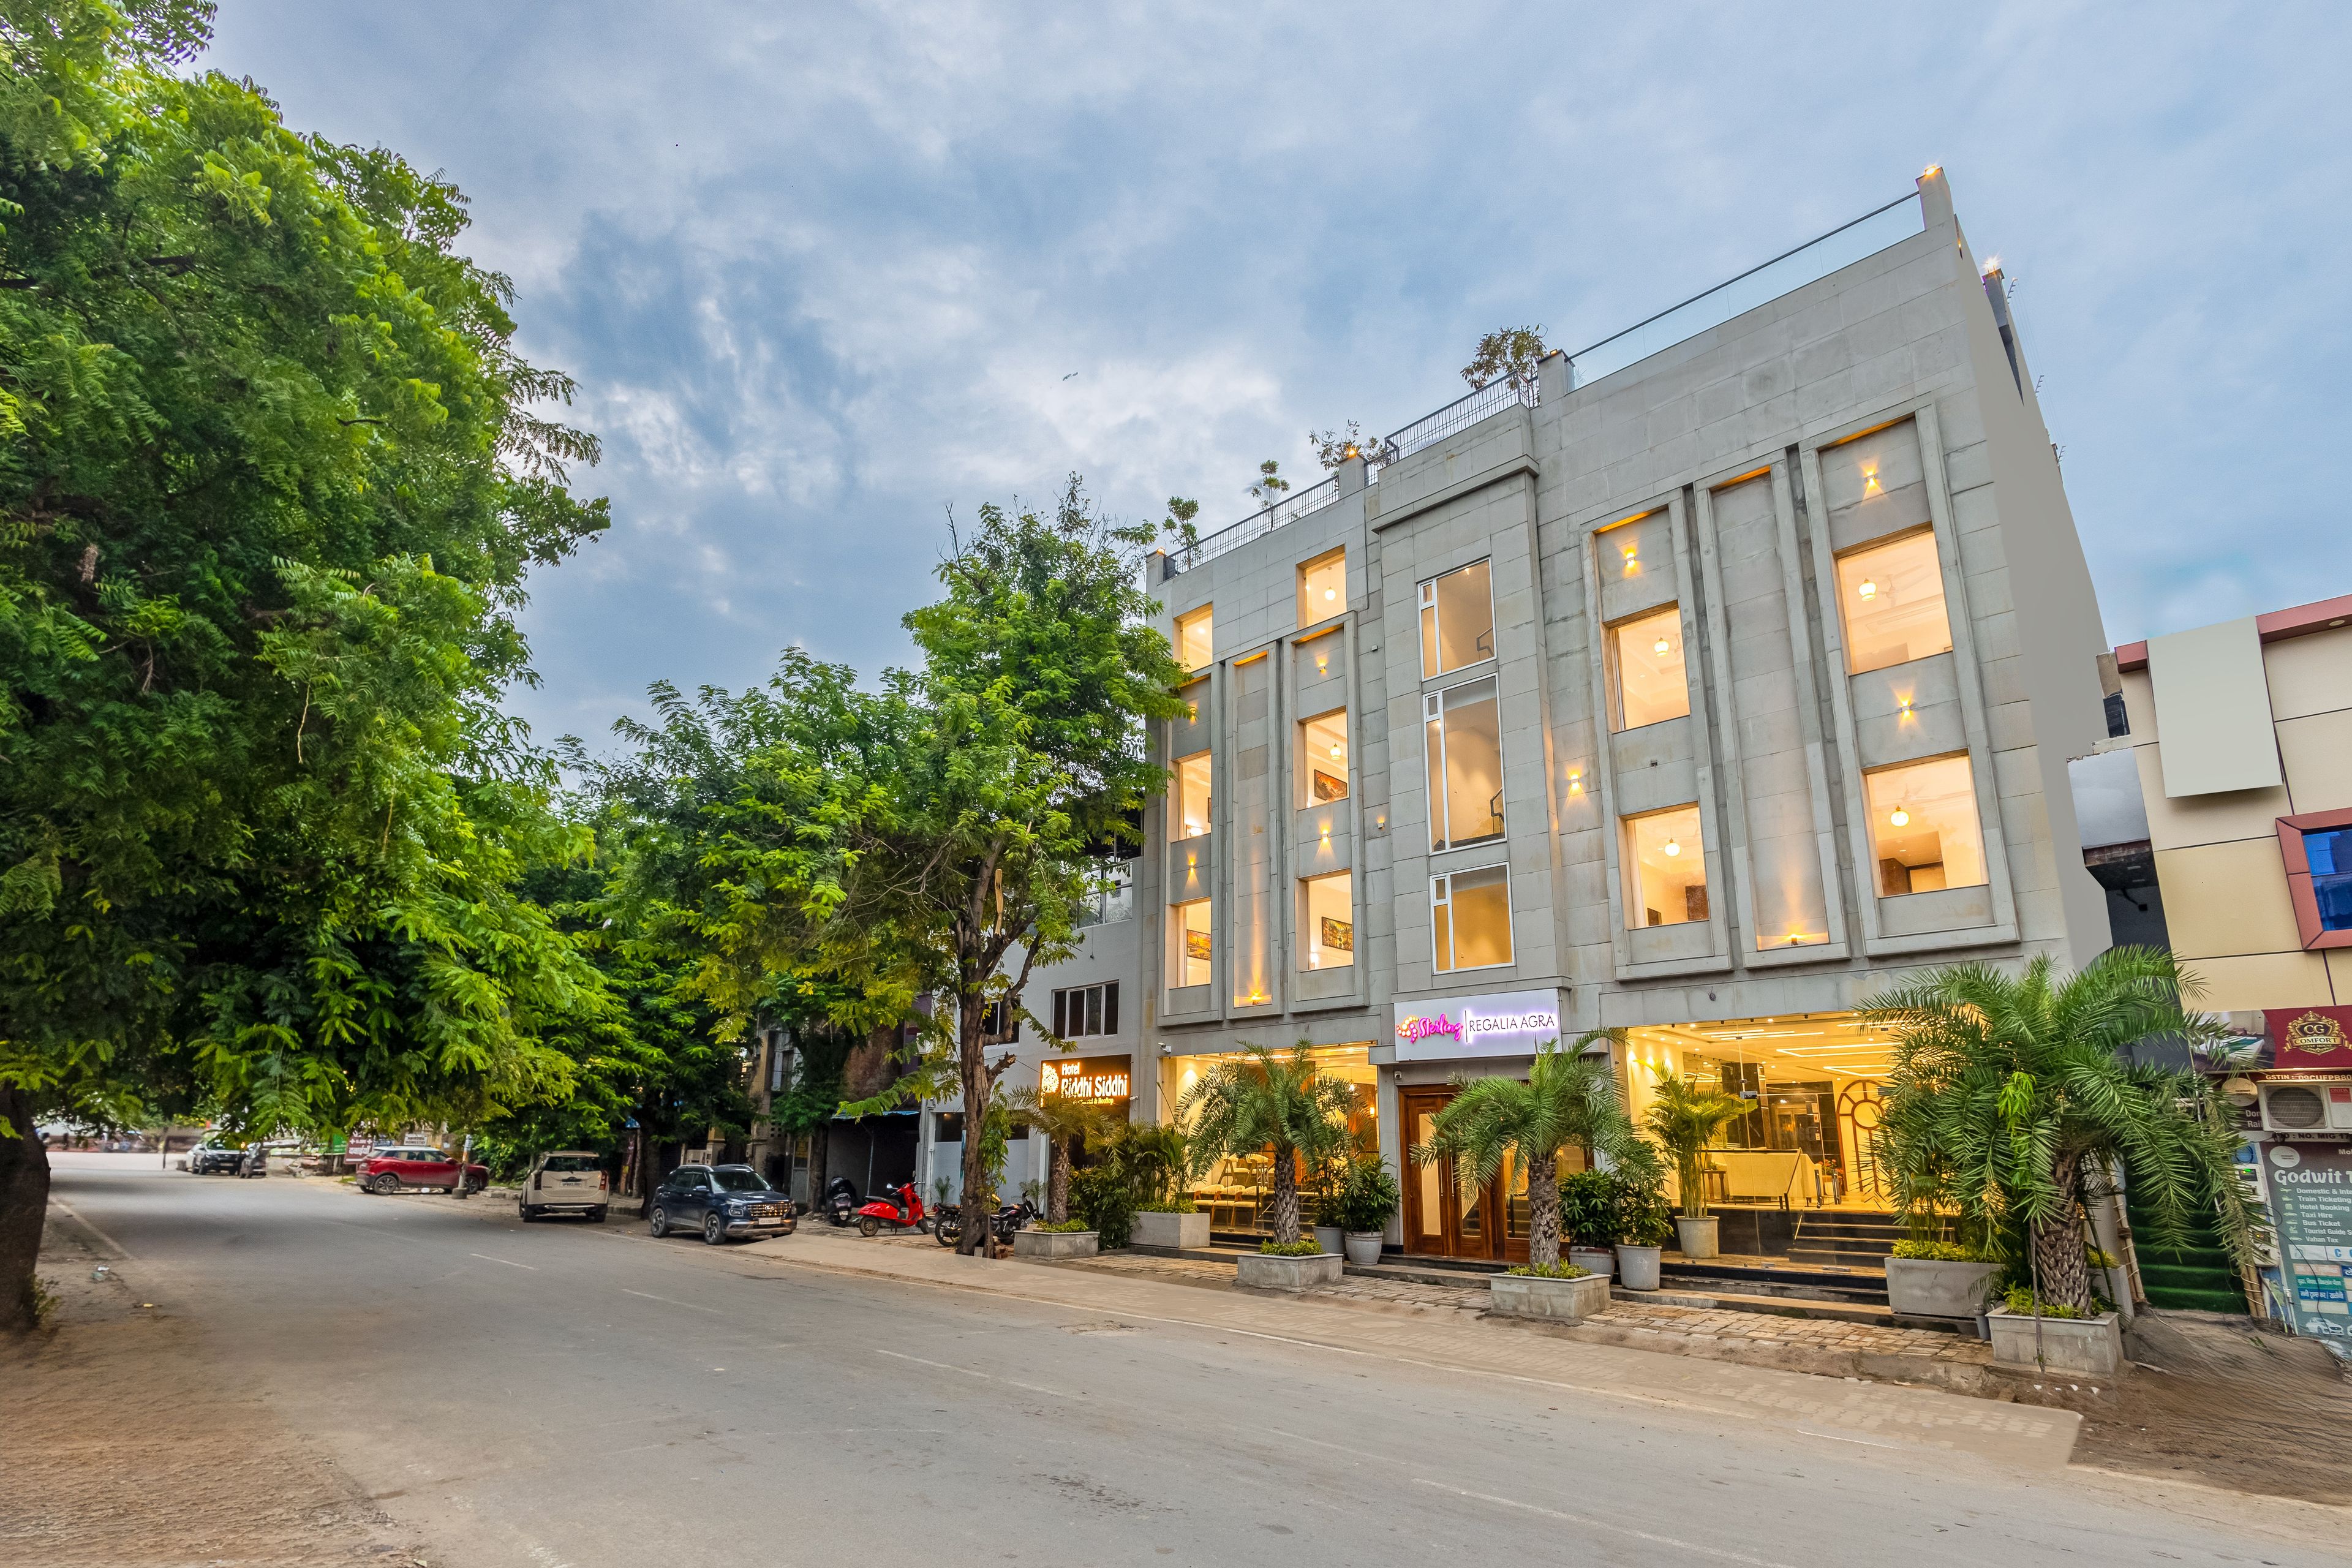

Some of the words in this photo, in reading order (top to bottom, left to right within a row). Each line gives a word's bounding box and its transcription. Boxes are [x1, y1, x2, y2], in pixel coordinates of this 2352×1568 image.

[1419, 1012, 1463, 1041] Sterling
[1469, 1017, 1518, 1032] REGALIA
[1520, 1014, 1555, 1029] AGRA
[2304, 1025, 2324, 1034] CG
[1061, 1062, 1080, 1076] Hotel
[1061, 1076, 1093, 1098] Riddhi
[1095, 1074, 1128, 1097] Siddhi
[2274, 1168, 2342, 1186] Godwit
